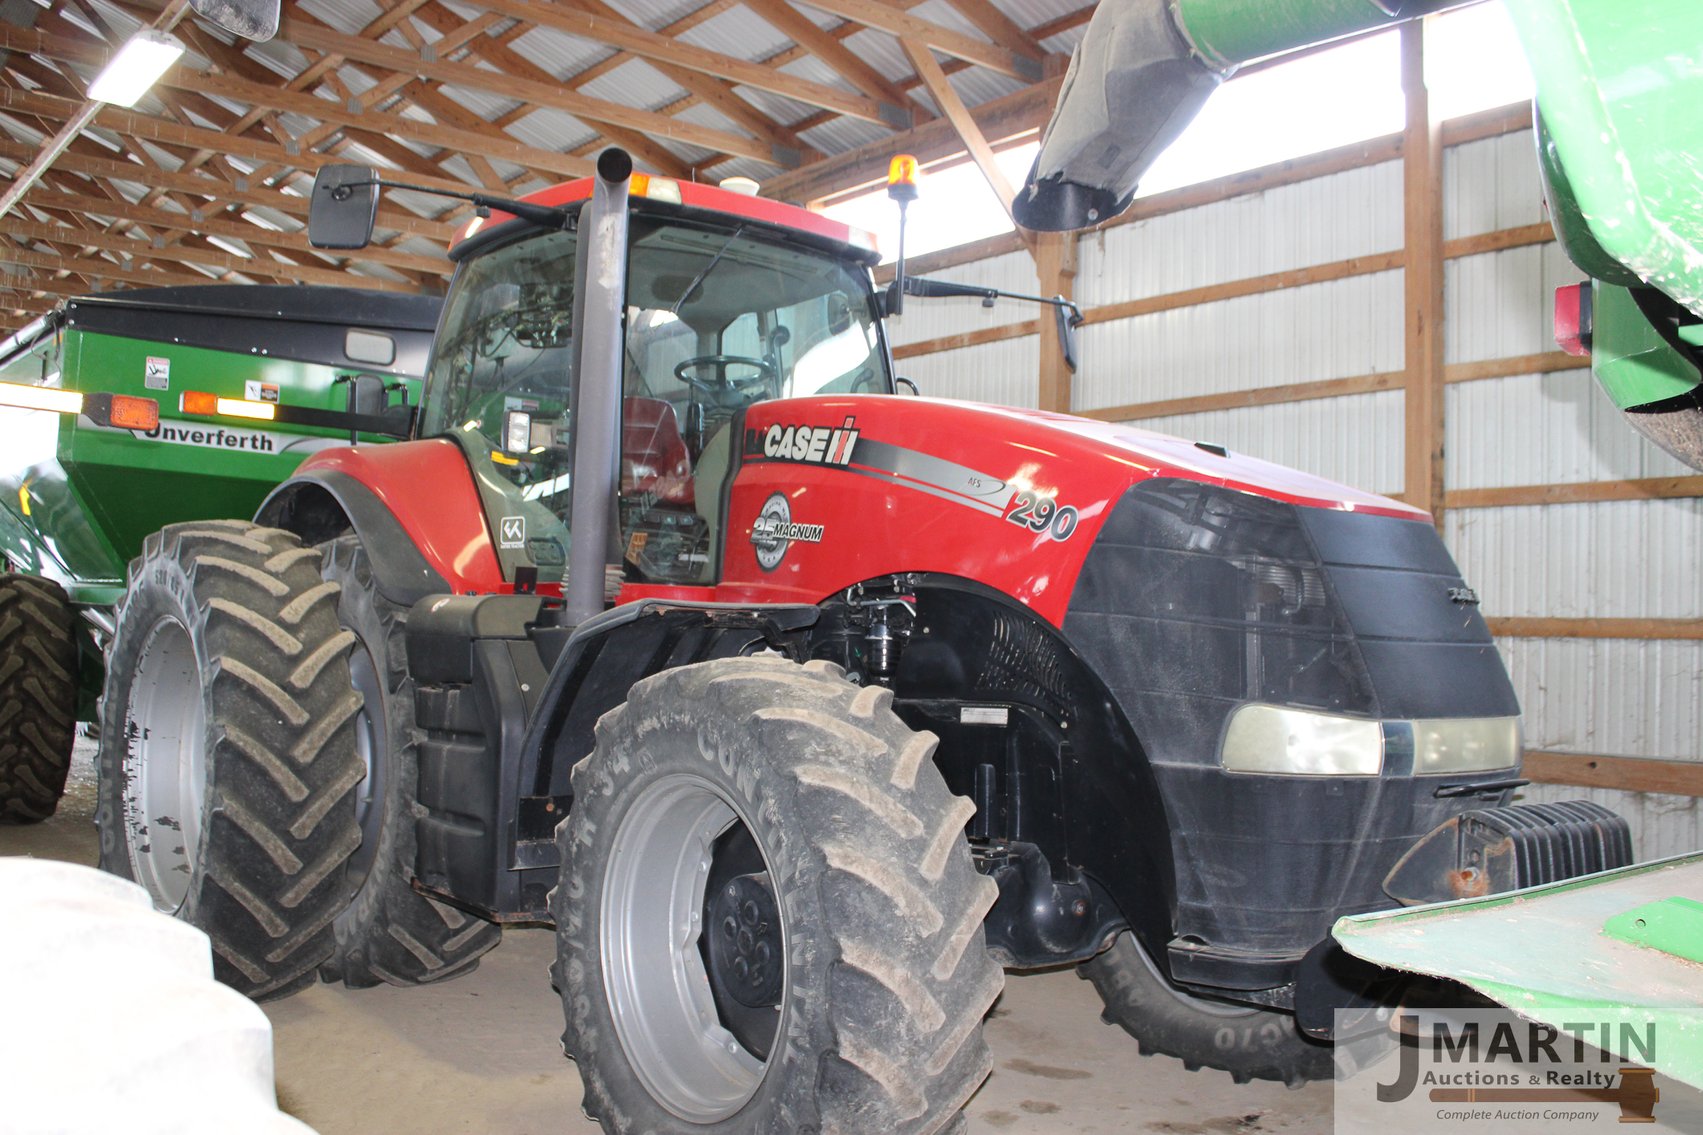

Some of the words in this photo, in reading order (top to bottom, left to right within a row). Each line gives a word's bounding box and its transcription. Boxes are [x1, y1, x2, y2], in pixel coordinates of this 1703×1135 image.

[764, 424, 831, 462] CASE
[967, 477, 982, 489] AFS
[1005, 491, 1080, 542] 290
[773, 523, 824, 541] MAGNUM
